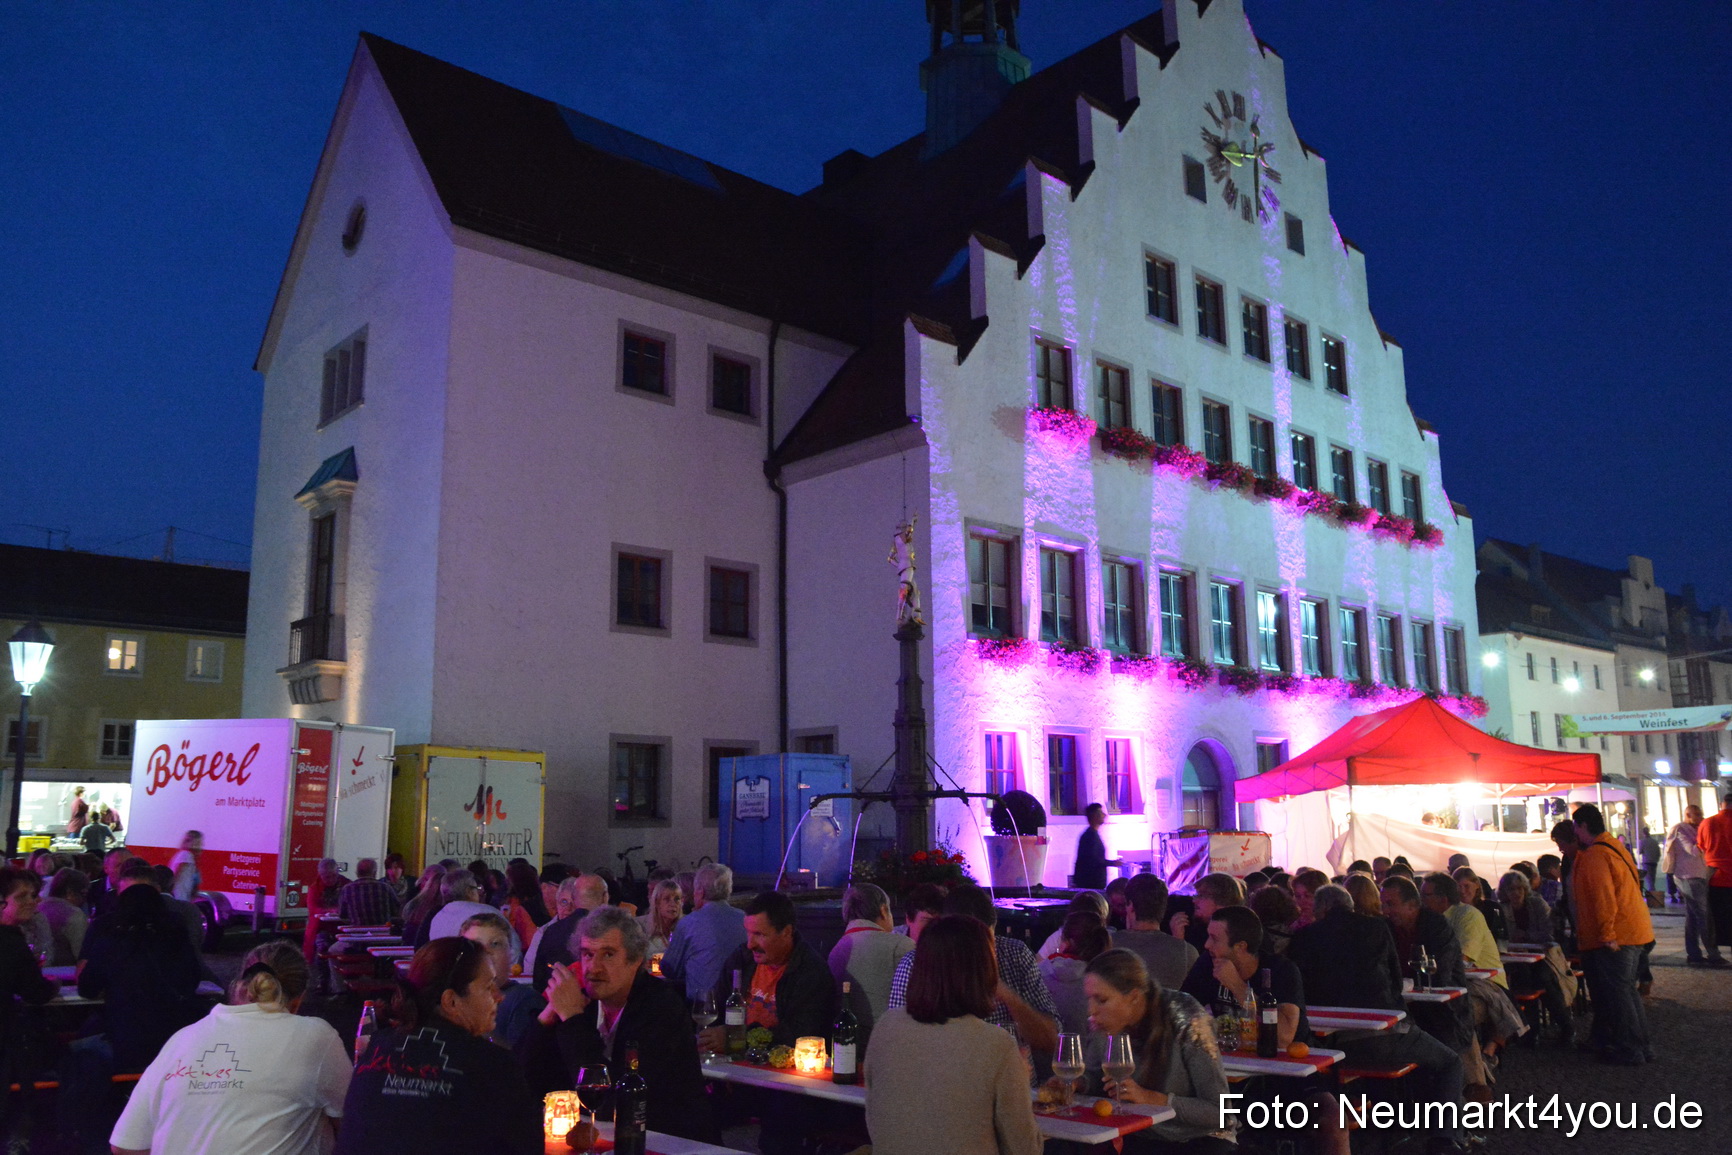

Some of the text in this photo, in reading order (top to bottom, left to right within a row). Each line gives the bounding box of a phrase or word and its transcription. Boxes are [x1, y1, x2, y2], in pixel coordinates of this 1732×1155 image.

[1640, 717, 1688, 729] Weinfest
[145, 739, 261, 796] Bögerl
[297, 761, 329, 775] Bögerl
[215, 797, 266, 809] am Marktplatz
[302, 819, 324, 828] Catering
[434, 828, 533, 856] NEUMARKTER
[230, 852, 262, 866] Metzgerei
[223, 865, 260, 878] Partyservice
[164, 1059, 233, 1081] aktives
[188, 1078, 245, 1090] Neumarkt
[384, 1072, 453, 1096] Neumarkt
